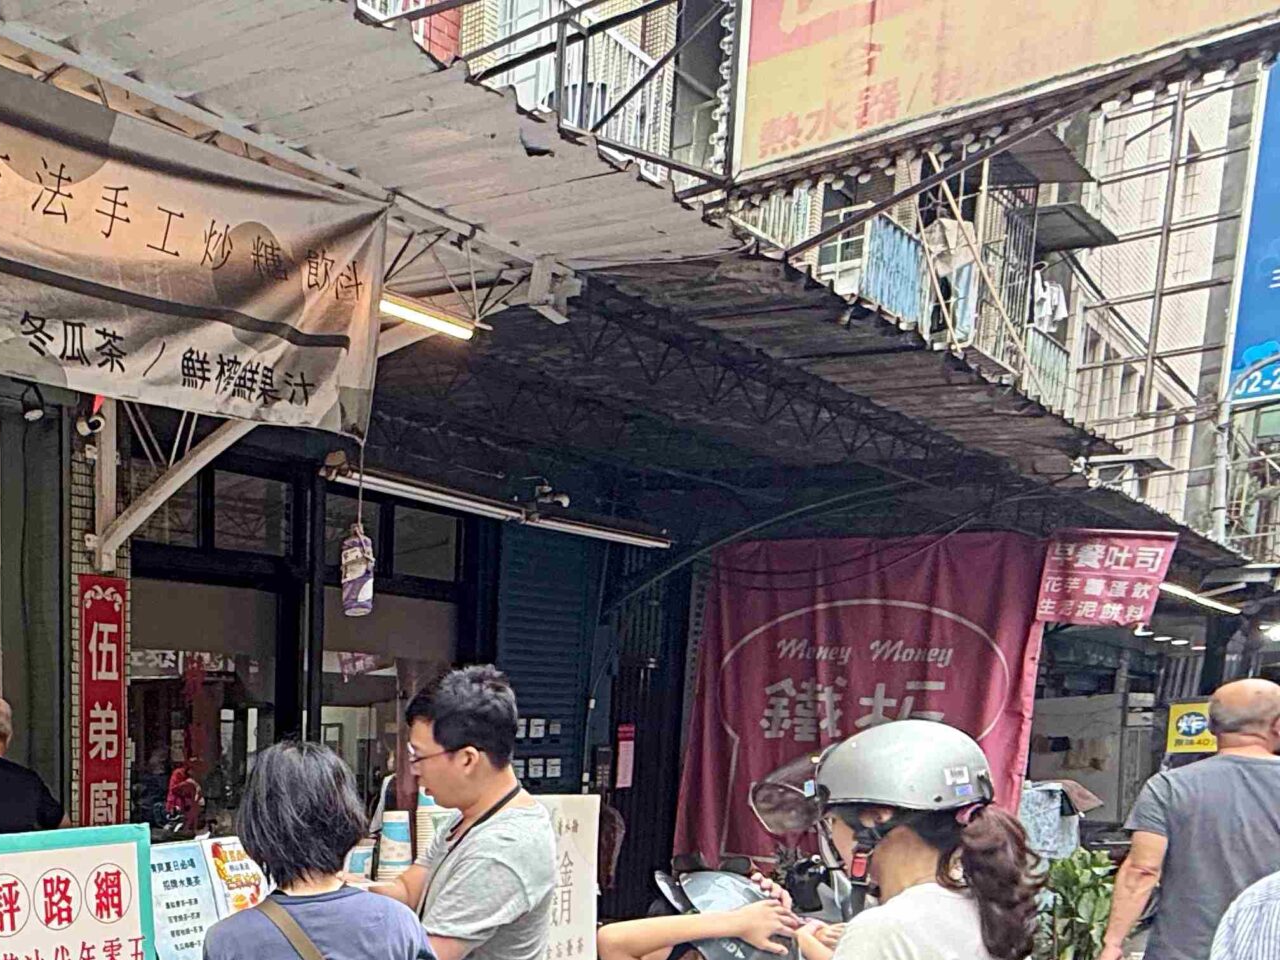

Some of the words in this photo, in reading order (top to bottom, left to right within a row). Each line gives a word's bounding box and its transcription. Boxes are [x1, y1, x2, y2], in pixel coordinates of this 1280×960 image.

[20, 311, 127, 373] 冬瓜茶
[1051, 543, 1165, 572] 早餐吐司
[777, 639, 852, 665] Money
[870, 640, 954, 667] Money
